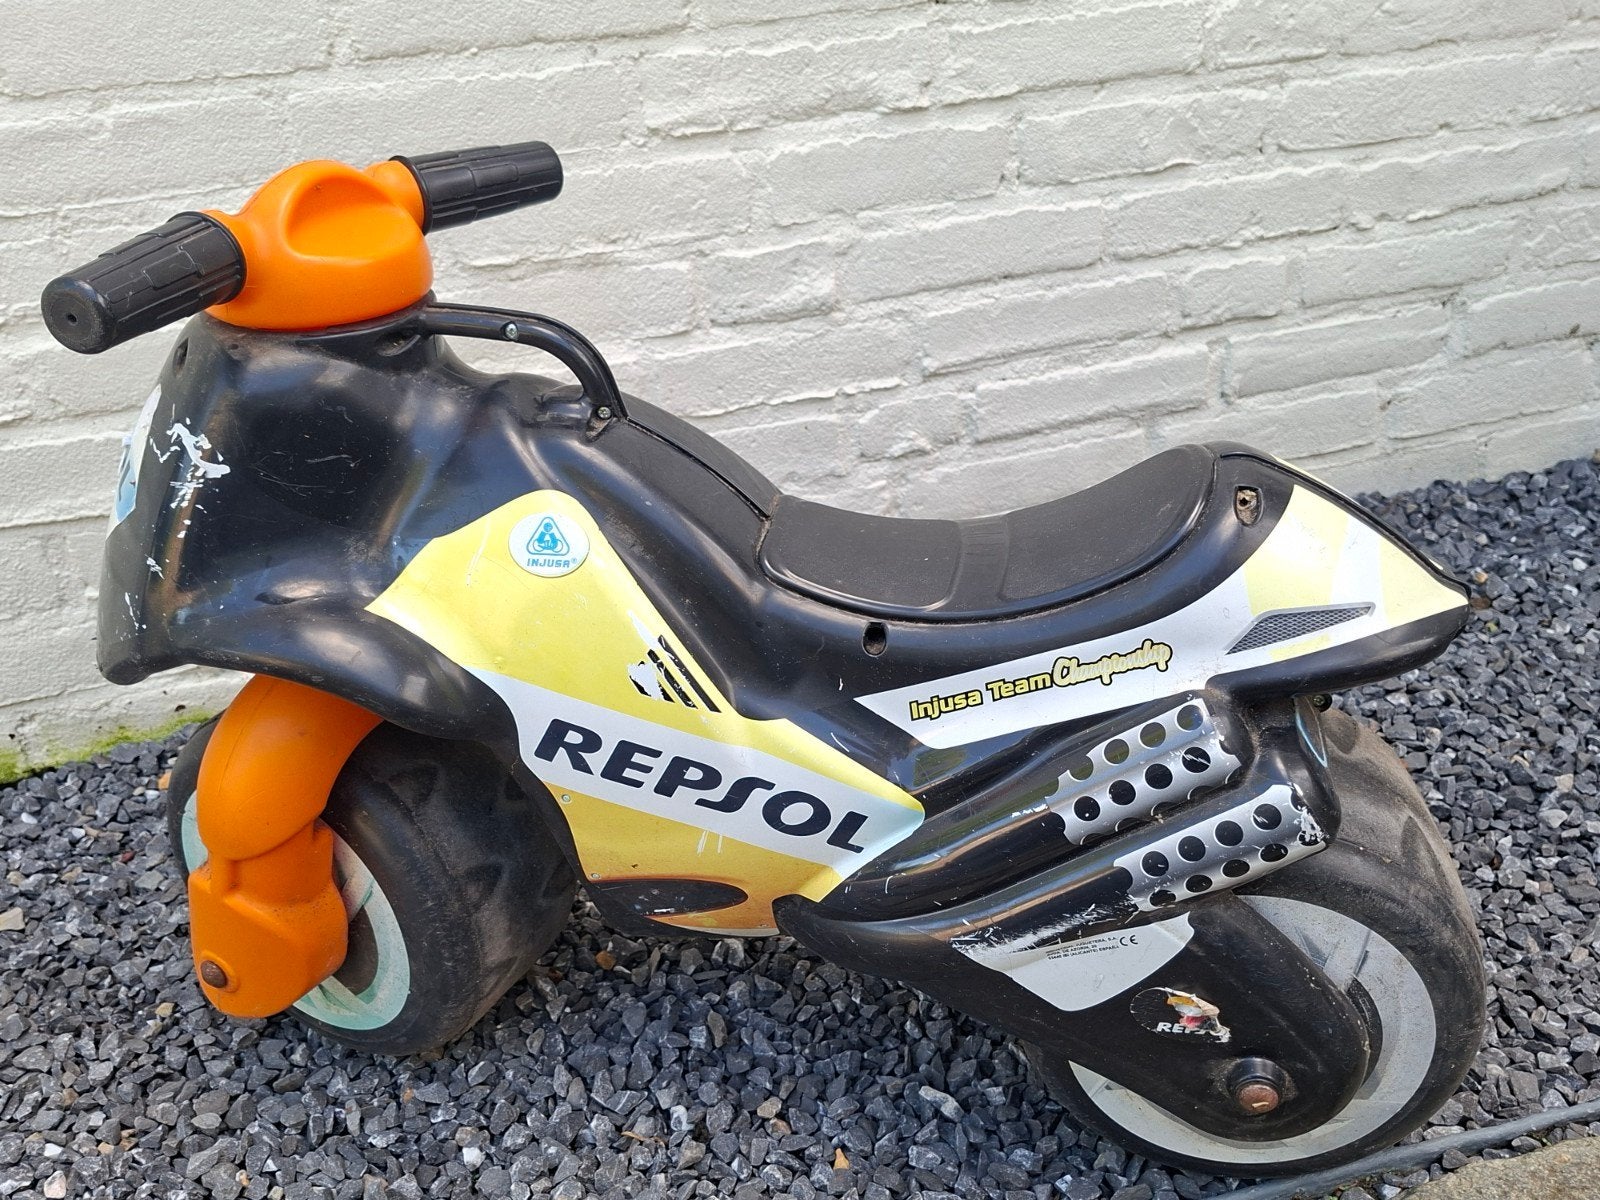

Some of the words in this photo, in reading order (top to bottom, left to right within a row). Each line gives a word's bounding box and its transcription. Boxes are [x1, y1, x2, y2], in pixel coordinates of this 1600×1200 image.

[909, 690, 983, 721] Injusa
[986, 672, 1053, 702] Team
[1052, 638, 1173, 686] Championship
[533, 718, 872, 854] REPSOL
